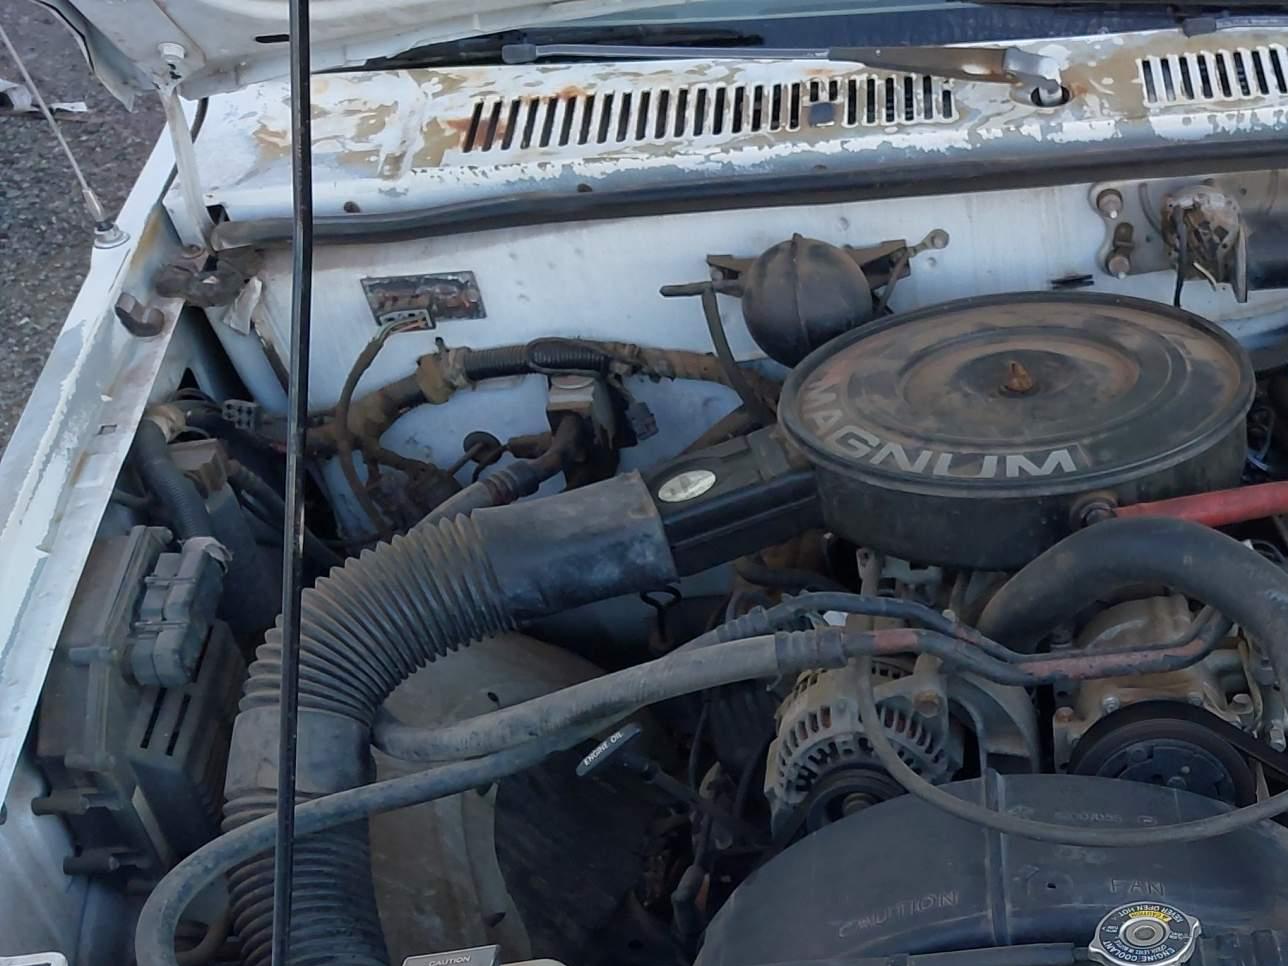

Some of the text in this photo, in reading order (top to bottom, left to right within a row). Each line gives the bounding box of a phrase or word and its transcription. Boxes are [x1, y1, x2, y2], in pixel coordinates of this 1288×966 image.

[801, 381, 1077, 479] MAGNUM
[583, 731, 625, 766] ENGINE OIL
[1109, 878, 1167, 897] FAN
[1119, 907, 1135, 917] HOT
[1161, 905, 1184, 923] NEVER
[428, 952, 472, 966] CAUTION
[1102, 940, 1176, 961] ENGINE COOLANT
